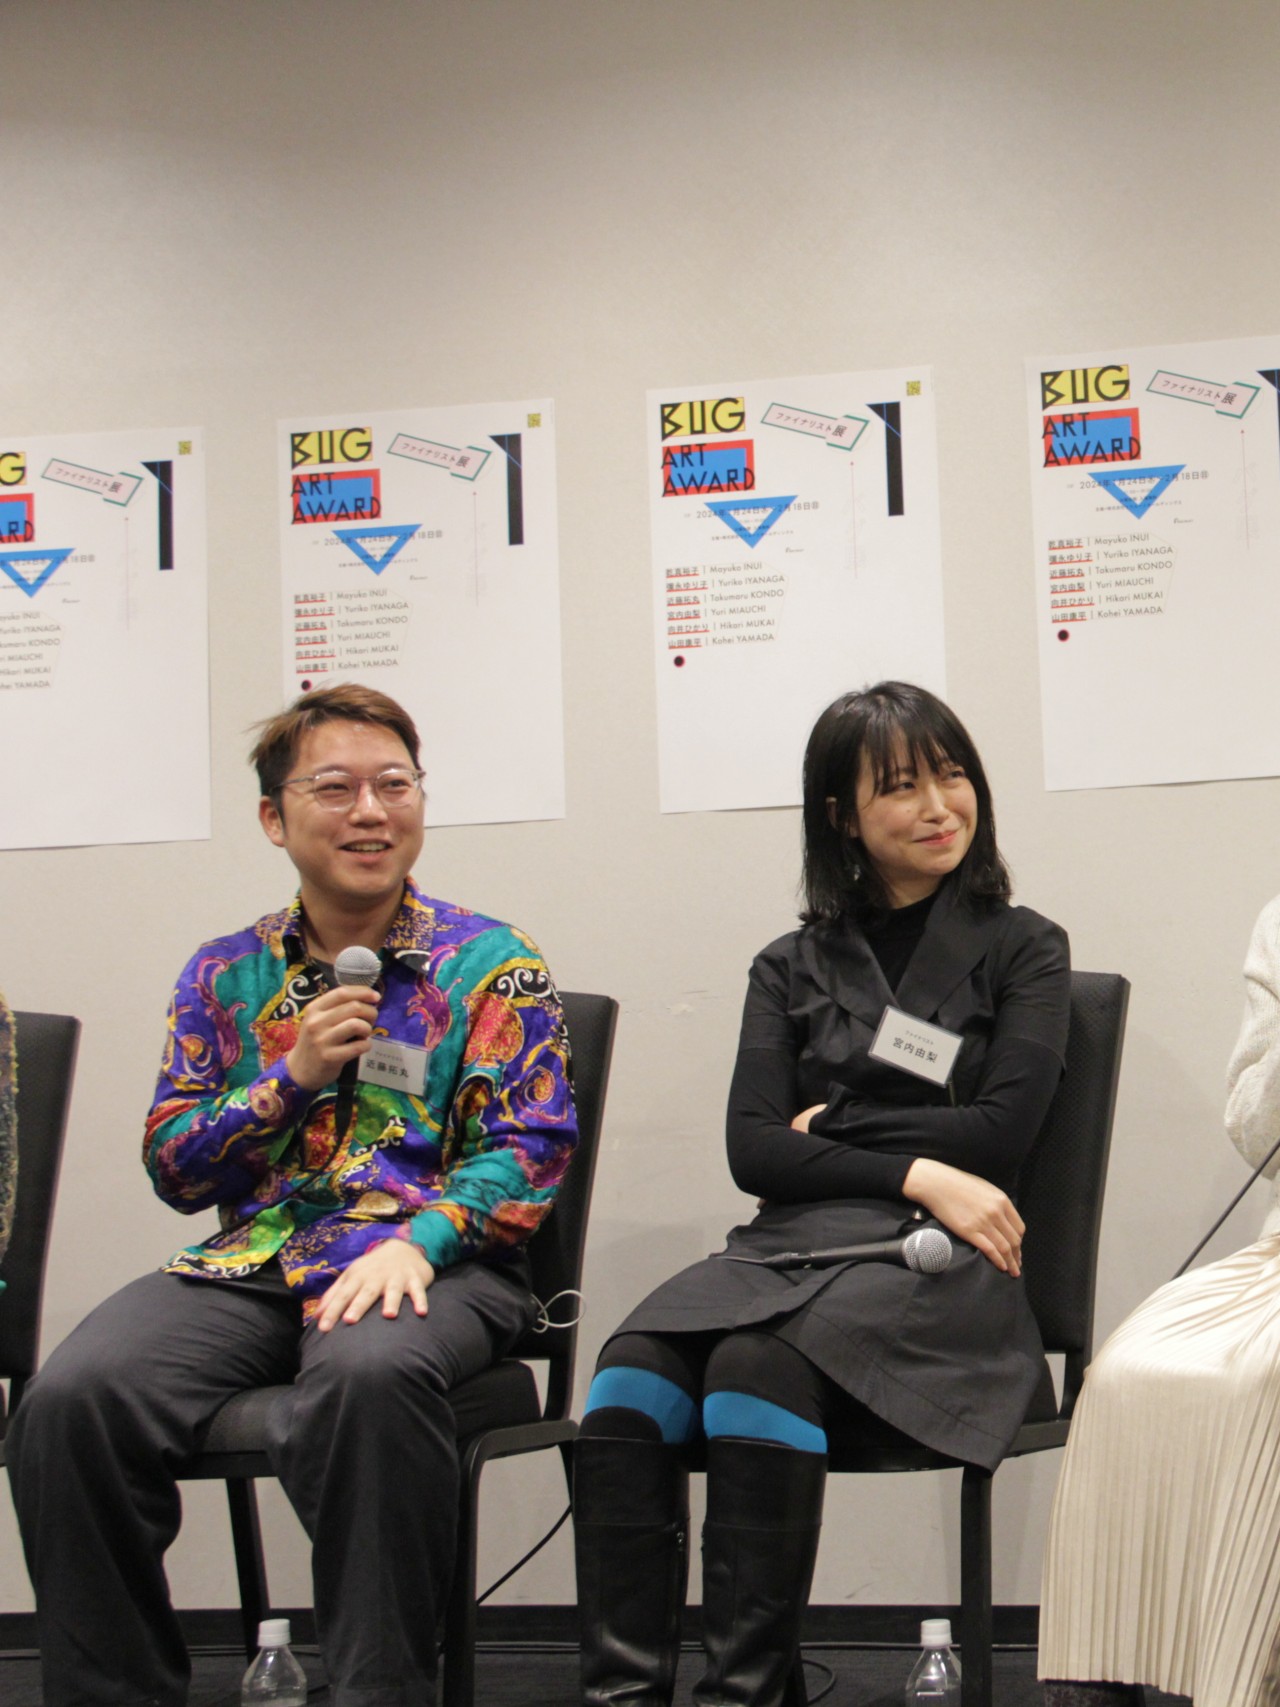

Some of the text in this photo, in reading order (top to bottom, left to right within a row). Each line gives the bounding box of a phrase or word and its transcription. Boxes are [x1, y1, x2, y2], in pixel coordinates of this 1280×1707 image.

[1041, 365, 1130, 410] BUG
[1162, 380, 1237, 405] ファイナリスト展
[661, 397, 746, 441] BUG
[776, 412, 847, 437] ファイナリスト展
[1042, 412, 1089, 439] ART
[291, 427, 373, 470] BUG
[661, 443, 706, 469] ART
[1043, 435, 1141, 468] AWARD
[291, 472, 335, 497] ART
[662, 466, 755, 497] AWARD
[291, 495, 381, 525] AWARD
[1130, 533, 1149, 542] INUI
[1132, 545, 1173, 557] IYANAGA
[1137, 560, 1173, 571] KONDO
[1114, 577, 1154, 587] MIAUCHI
[1133, 590, 1163, 600] MUKAI
[1123, 605, 1162, 616] YAMADA
[892, 1037, 938, 1063] 宮内由梨
[365, 1058, 409, 1078] 近藤拓丸
